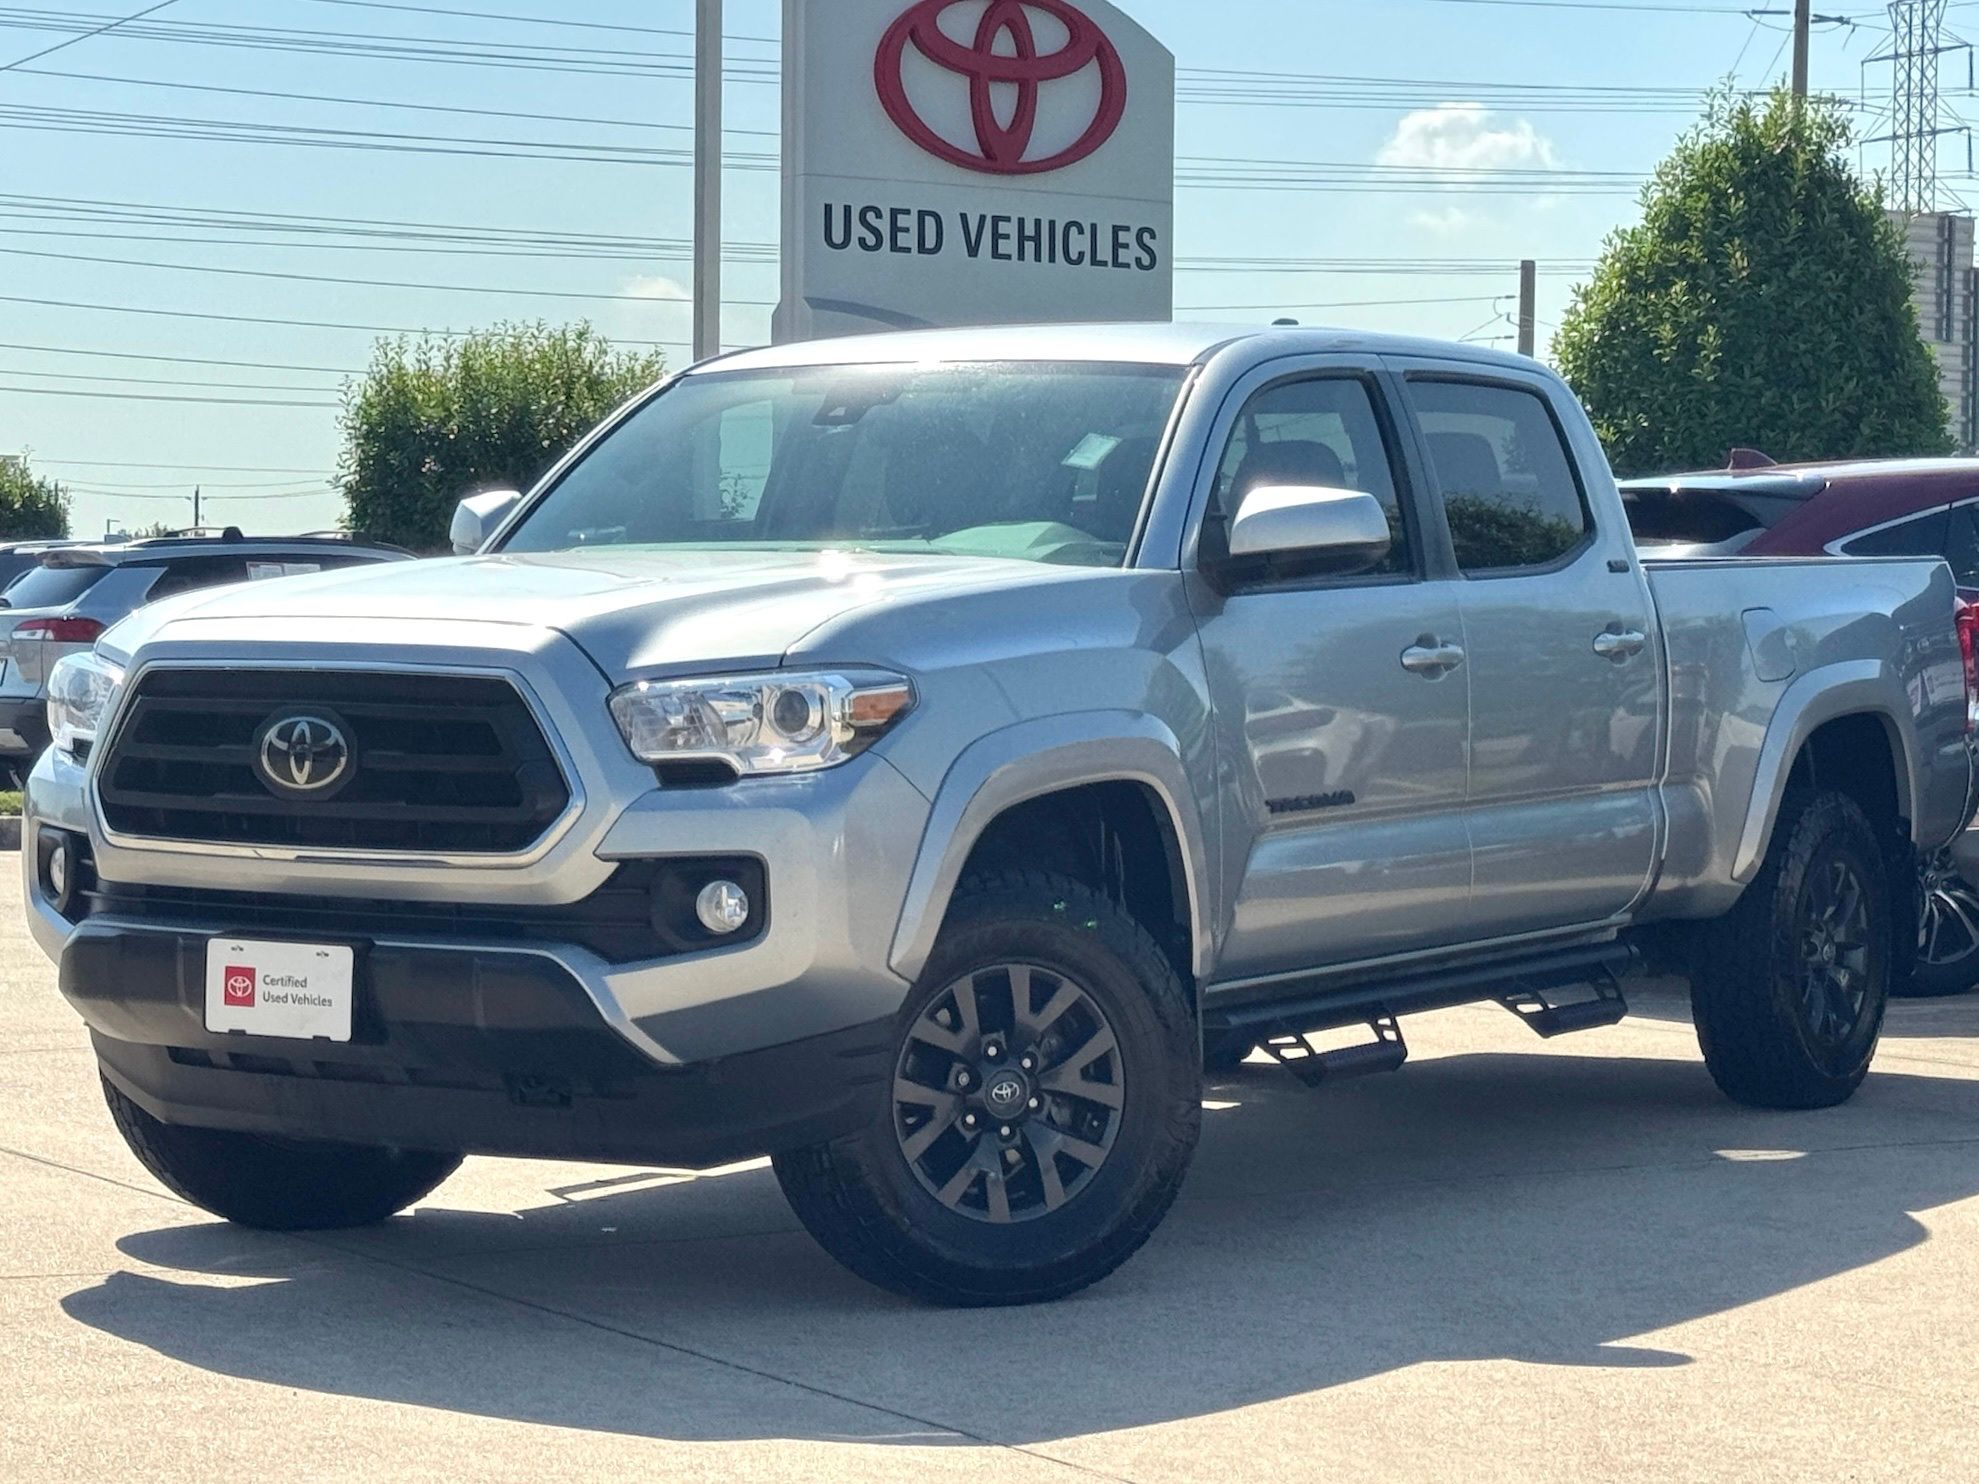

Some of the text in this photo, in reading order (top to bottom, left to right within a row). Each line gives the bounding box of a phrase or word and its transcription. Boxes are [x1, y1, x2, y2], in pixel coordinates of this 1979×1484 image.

[824, 203, 1157, 271] USED VEHICLES
[262, 974, 308, 988] Certified
[262, 991, 333, 1007] Used Vehicles
